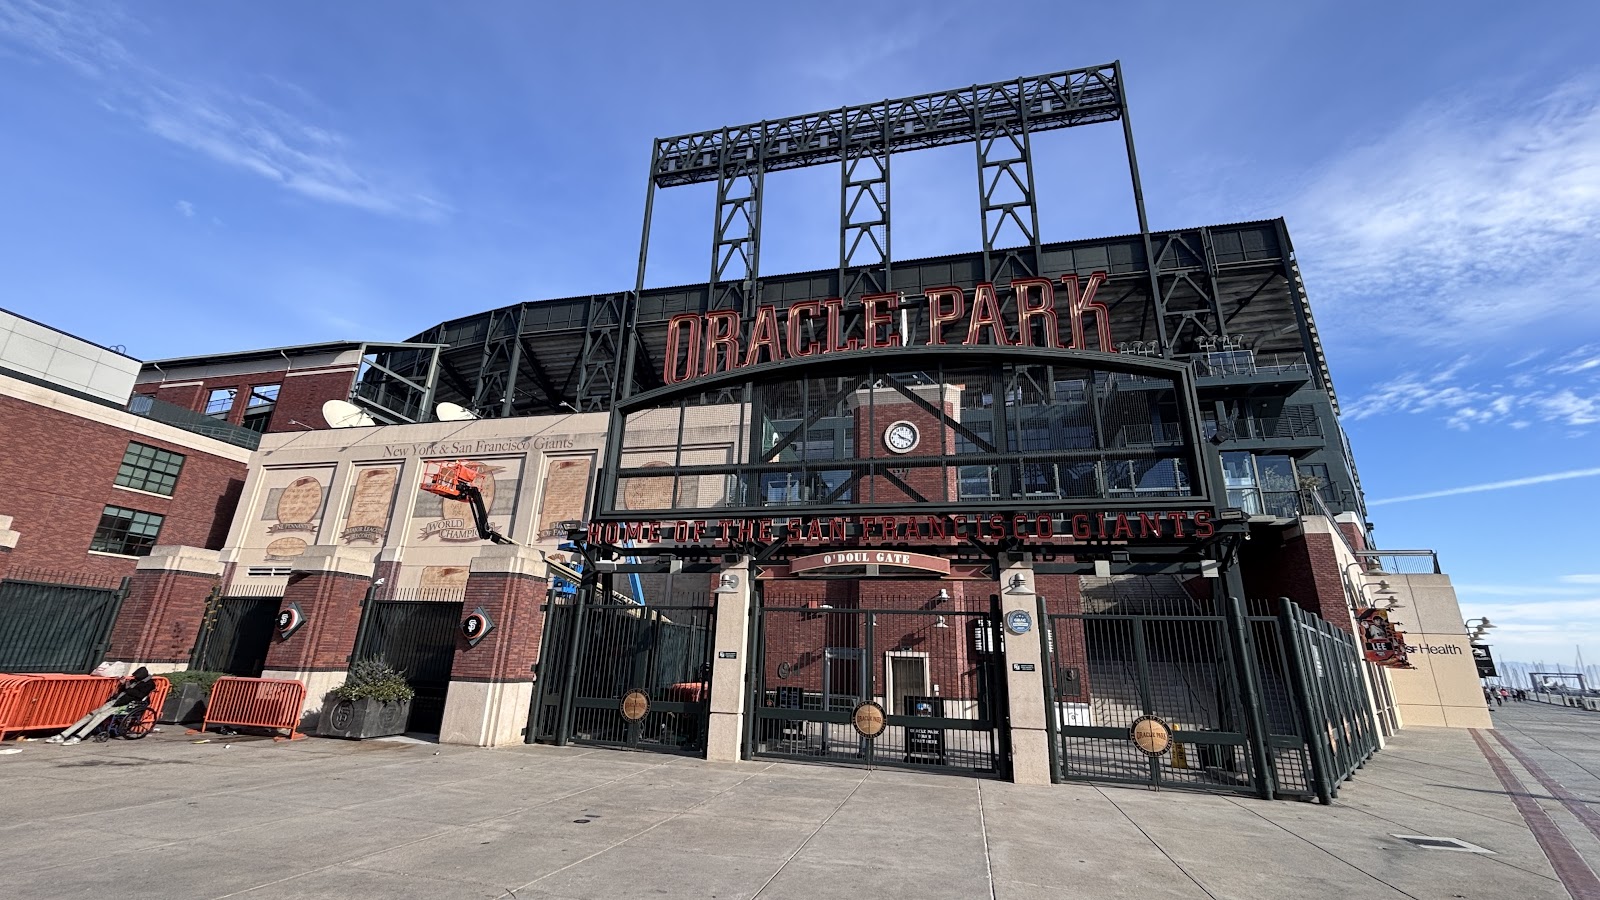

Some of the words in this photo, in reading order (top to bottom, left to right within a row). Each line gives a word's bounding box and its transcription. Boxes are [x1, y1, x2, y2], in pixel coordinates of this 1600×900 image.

[664, 292, 901, 385] ORACLE
[924, 271, 1118, 354] PARK
[382, 445, 409, 457] New
[412, 443, 437, 456] York
[438, 444, 449, 455] &
[451, 441, 472, 454] San
[475, 439, 530, 453] Francisco
[533, 437, 574, 450] Giants
[428, 519, 463, 531] WORLD
[587, 520, 662, 544] HOME
[674, 520, 707, 544] OF
[719, 518, 774, 543] THE
[787, 517, 848, 542] SAN
[862, 514, 1053, 541] FRANCISCO
[1072, 511, 1215, 539] GIANTS
[824, 552, 870, 565] O'DOUL
[876, 552, 910, 565] GATE
[1371, 642, 1387, 651] LEE
[1405, 645, 1418, 654] SF
[1418, 643, 1463, 655] Health
